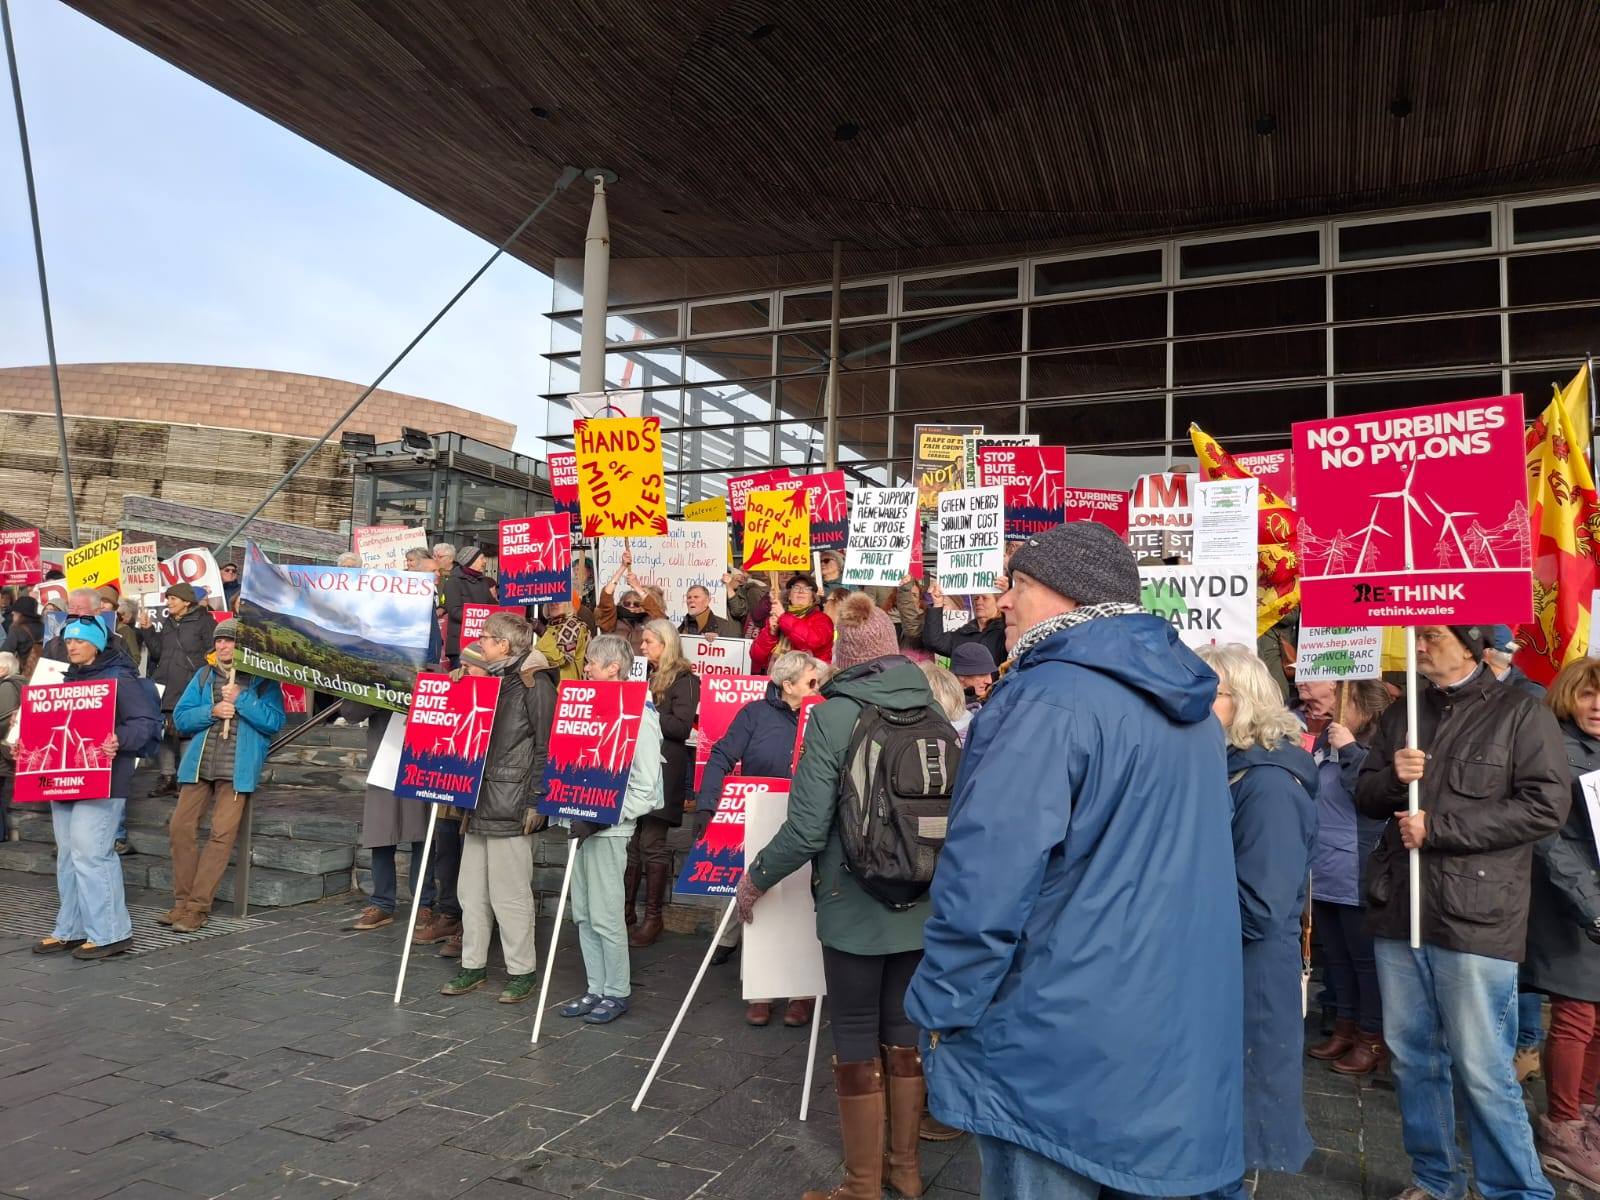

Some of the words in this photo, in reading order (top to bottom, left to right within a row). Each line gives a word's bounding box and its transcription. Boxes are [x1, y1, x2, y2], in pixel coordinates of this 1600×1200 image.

[1307, 425, 1349, 450] NO
[1354, 406, 1505, 444] TURBINES
[580, 428, 656, 454] HANDS
[983, 452, 1016, 463] STOP
[1321, 446, 1364, 470] NO
[1370, 432, 1491, 465] PYLONS
[551, 456, 577, 467] STOP
[552, 466, 578, 476] BUTE
[922, 464, 954, 487] NOT
[984, 464, 1016, 474] BUTE
[582, 461, 611, 507] MID
[730, 479, 754, 490] STOP
[776, 480, 804, 491] STOP
[984, 475, 1033, 487] ENERGY
[857, 491, 873, 506] WE
[878, 490, 916, 507] SUPPORT
[1075, 491, 1124, 502] TURBINES
[941, 497, 966, 514] GREEN
[970, 494, 999, 511] ENERGY
[1078, 499, 1120, 511] PYLONS
[746, 494, 792, 529] hands
[858, 507, 908, 519] RENEWABLES
[748, 518, 771, 534] off
[853, 521, 868, 534] WE
[873, 521, 906, 534] OPPOSE
[977, 512, 999, 530] COST
[502, 522, 530, 536] STOP
[503, 532, 531, 546] BUTE
[849, 535, 888, 549] RECKLESS
[889, 534, 911, 550] ONES
[940, 534, 966, 550] GREEN
[969, 532, 999, 548] SPACES
[66, 536, 120, 570] RESIDENTS
[121, 544, 154, 555] PRESERVE
[503, 542, 544, 556] ENERGY
[770, 548, 808, 566] Wales
[860, 553, 893, 565] PROTECT
[950, 553, 984, 569] PROTECT
[82, 571, 100, 585] say
[128, 573, 156, 585] WALES
[504, 581, 567, 599] RE-THINK
[1353, 583, 1466, 604] RE-THINK
[466, 608, 490, 618] STOP
[1368, 605, 1455, 618] rethink.wales
[1309, 628, 1344, 637] ENERGY
[697, 642, 726, 658] Dim
[1300, 636, 1377, 650] www.shep.wales
[1301, 650, 1348, 662] STOPIWCH
[1349, 649, 1374, 660] BARC
[242, 647, 292, 678] Friends
[294, 665, 309, 681] of
[311, 668, 371, 698] Radnor
[1299, 667, 1320, 676] YNNI
[1322, 664, 1374, 676] HIRFYNYDD
[418, 680, 451, 694] STOP
[708, 678, 732, 690] NO
[28, 688, 48, 702] NO
[48, 684, 110, 699] TURBINES
[562, 687, 597, 702] STOP
[714, 691, 738, 704] NO
[32, 701, 53, 714] NO
[54, 697, 104, 713] PYLONS
[415, 695, 448, 710] BUTE
[559, 703, 594, 720] BUTE
[412, 712, 462, 728] ENERGY
[556, 720, 608, 737] ENERGY
[38, 775, 85, 788] RE-THINK
[401, 764, 475, 794] RE-THINK
[415, 789, 454, 803] rethink.wales
[545, 779, 620, 809] RE-THINK
[725, 783, 769, 796] STOP
[559, 806, 598, 818] rethink.wales
